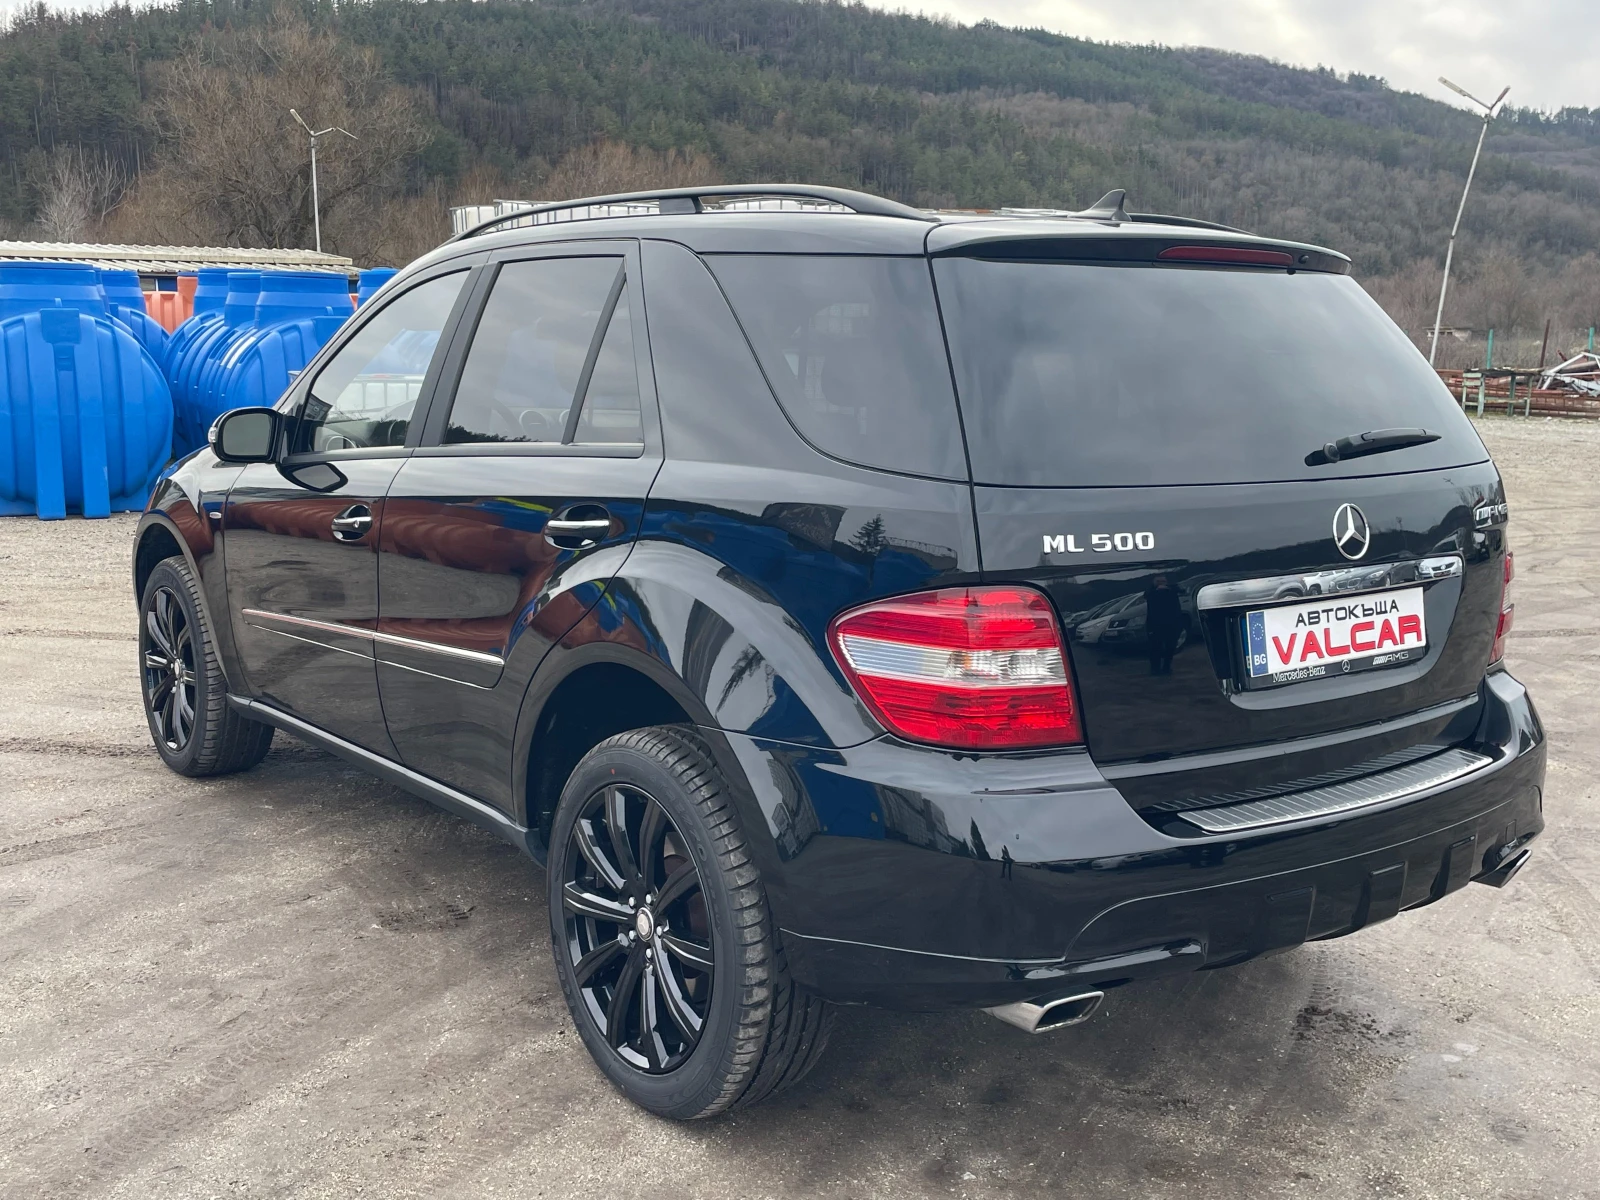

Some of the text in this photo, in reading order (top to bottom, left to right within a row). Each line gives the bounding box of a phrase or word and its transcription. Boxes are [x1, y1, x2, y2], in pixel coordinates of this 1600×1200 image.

[1042, 531, 1155, 554] ML 500
[1295, 599, 1400, 628] АВТОКЪША
[1271, 613, 1423, 666] VALCAR
[1253, 653, 1267, 666] BG
[1272, 665, 1326, 683] Mercedes-Benz
